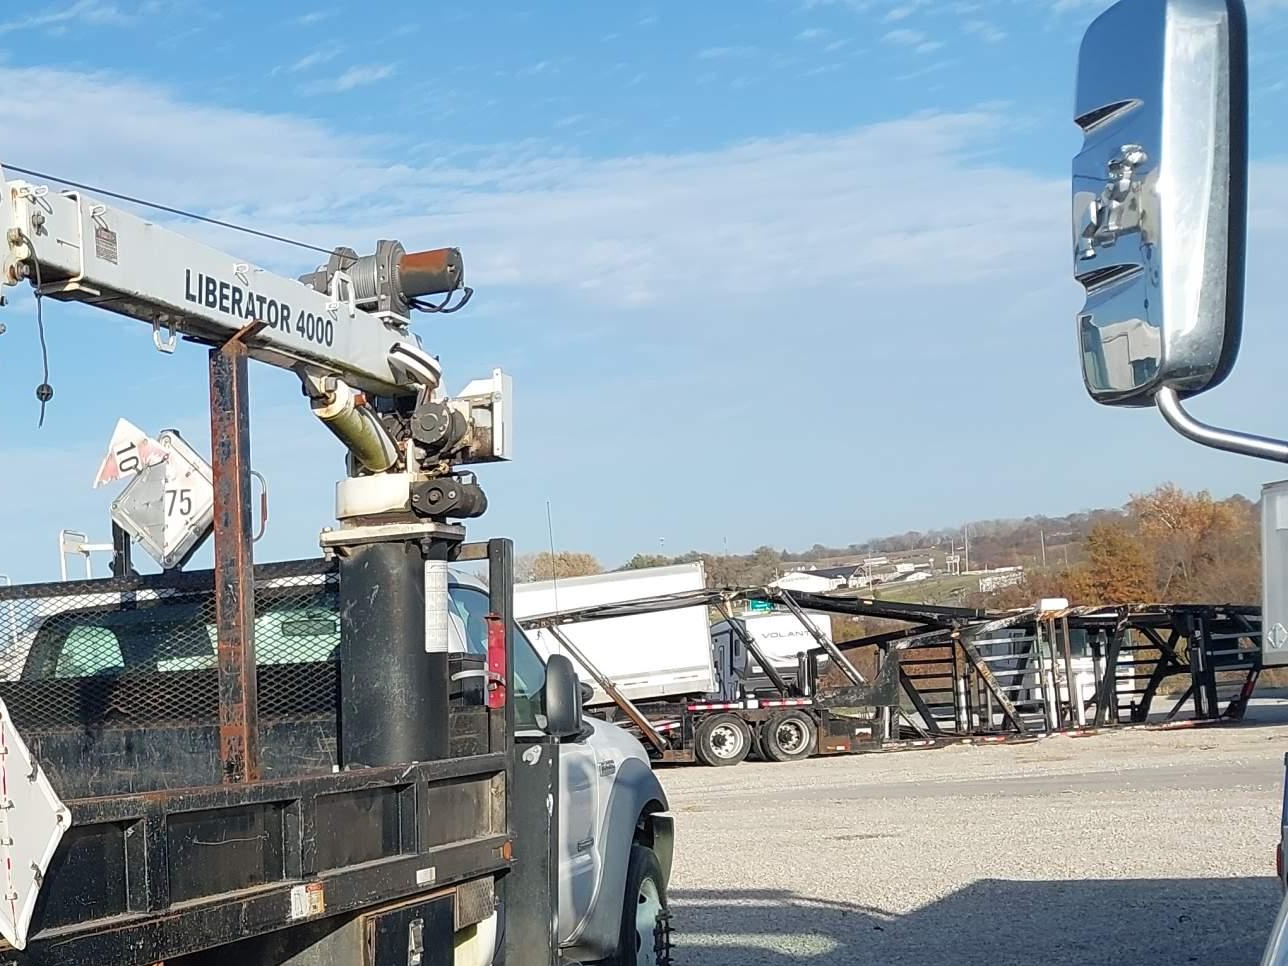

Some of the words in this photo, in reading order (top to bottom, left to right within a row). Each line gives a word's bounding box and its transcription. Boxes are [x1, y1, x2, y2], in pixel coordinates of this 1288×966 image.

[184, 268, 292, 334] LIBERATOR
[295, 309, 334, 347] 4000
[165, 489, 192, 517] 75
[761, 630, 810, 639] VOLANT
